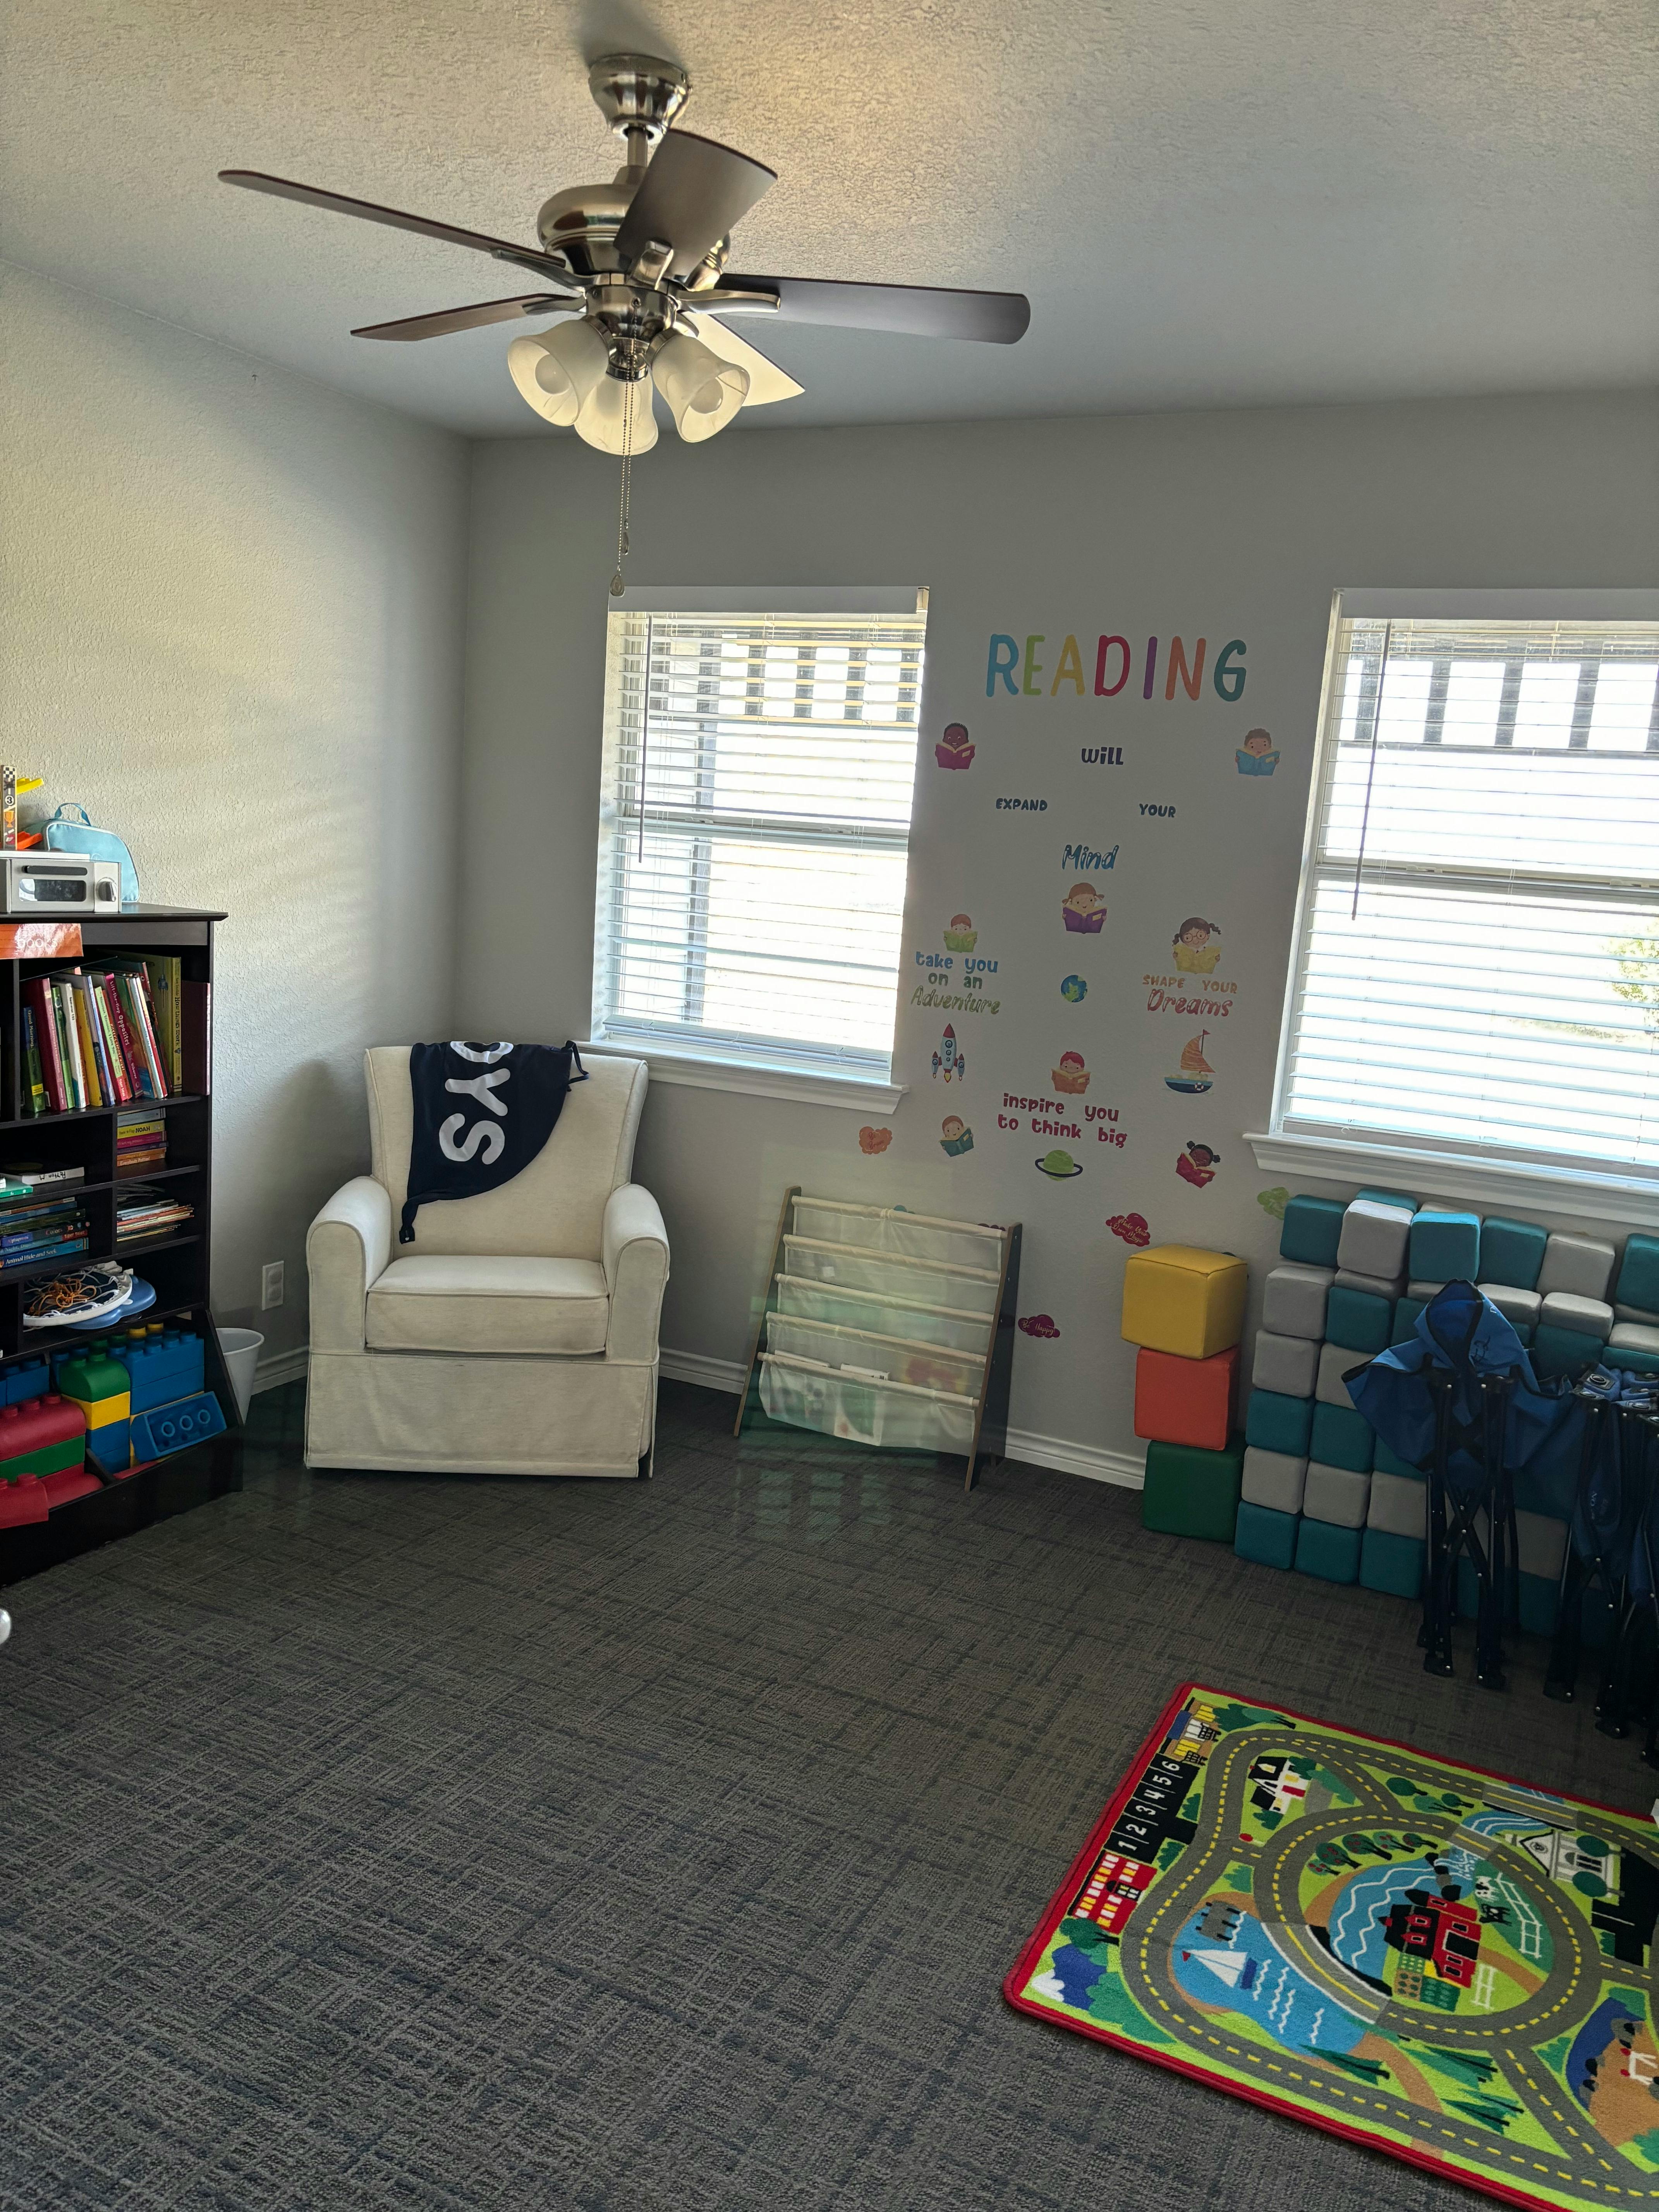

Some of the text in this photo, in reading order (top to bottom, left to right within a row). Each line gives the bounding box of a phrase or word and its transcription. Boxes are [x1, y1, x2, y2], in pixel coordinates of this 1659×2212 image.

[986, 634, 1247, 701] READING
[996, 798, 1176, 818] EXPAND YOUR
[1061, 844, 1120, 870] Mind
[915, 951, 998, 974] take you
[928, 972, 982, 989] on an
[1142, 974, 1238, 994] SHAPE YOUR
[910, 985, 1001, 1015] Adventure
[1147, 988, 1233, 1017] Dreams
[118, 1015, 130, 1046] Opposites
[1003, 1092, 1119, 1122] inspire you
[998, 1114, 1128, 1148] to think big
[1118, 1218, 1147, 1237] Make Your
[5, 1255, 24, 1265] Animal
[1022, 1320, 1054, 1336] Be Happy
[1118, 1761, 1180, 1851] 1 2 3 4 5 6
